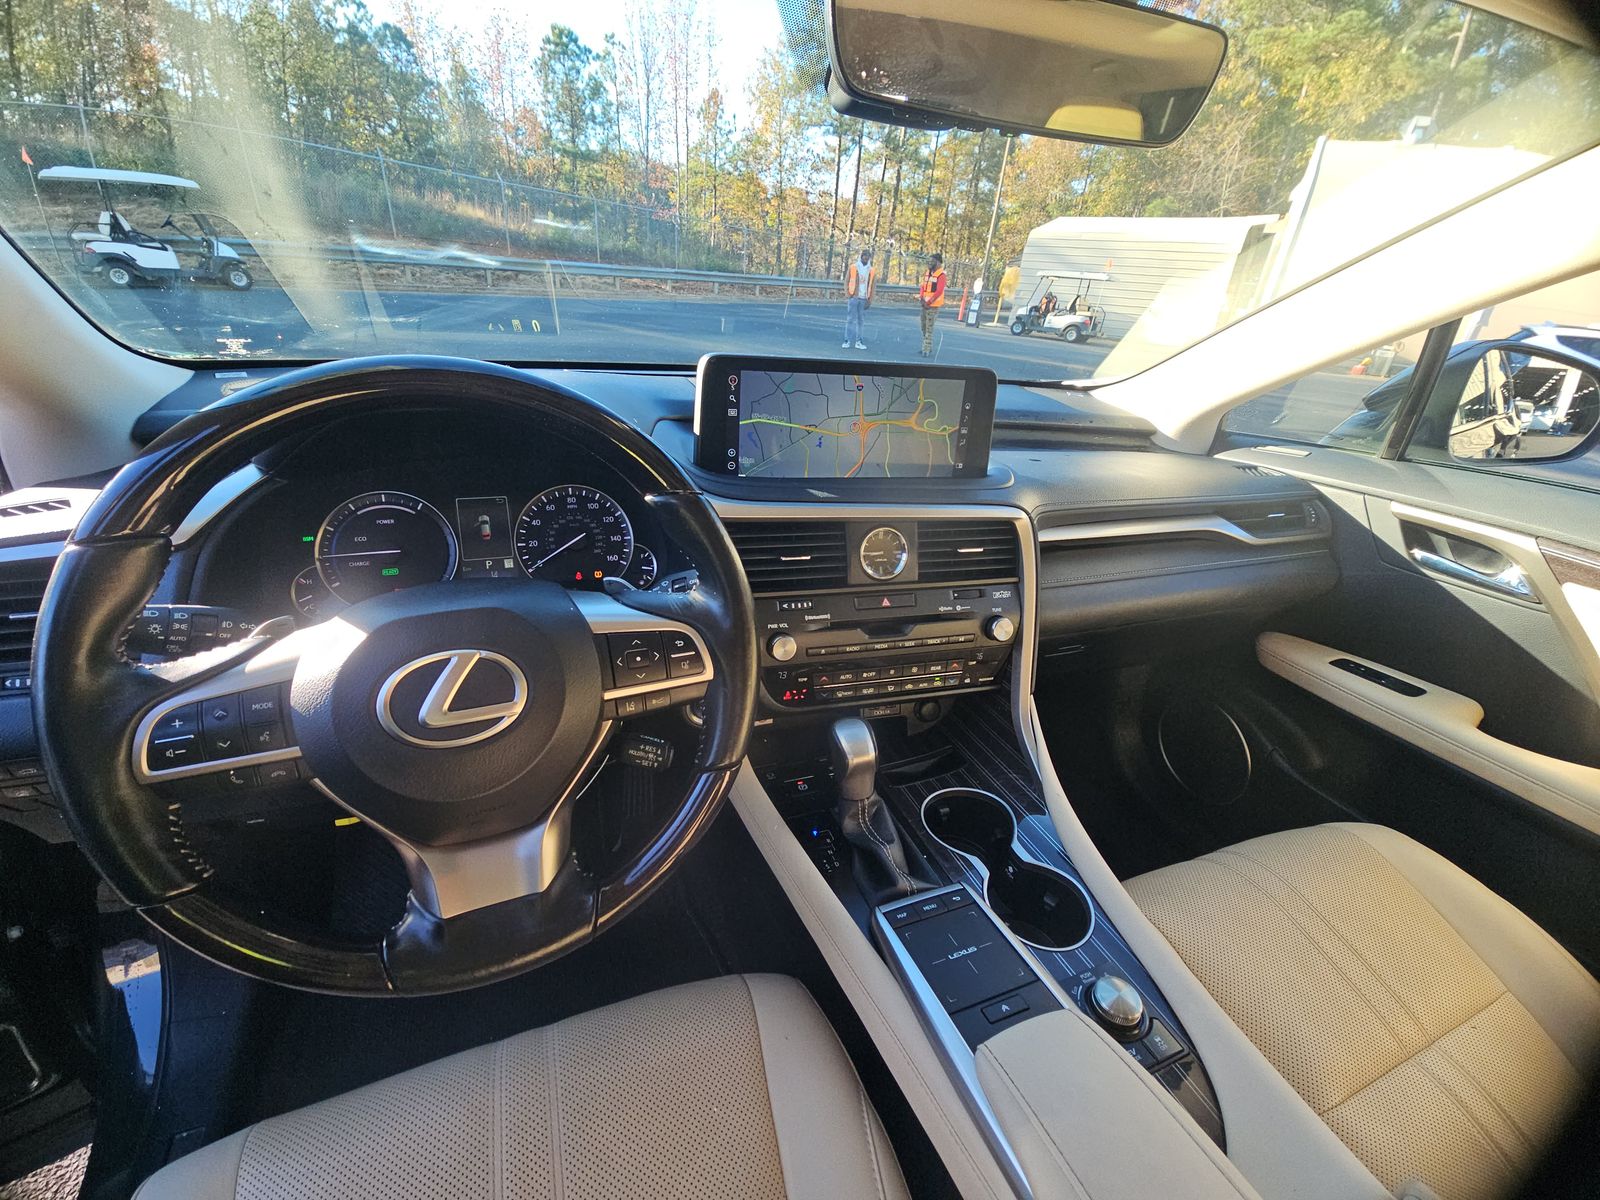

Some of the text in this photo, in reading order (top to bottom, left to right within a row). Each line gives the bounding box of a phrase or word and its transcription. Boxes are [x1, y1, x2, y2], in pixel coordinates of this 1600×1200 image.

[485, 560, 493, 569] P
[777, 671, 788, 679] 73
[251, 701, 274, 710] MODE
[923, 903, 937, 911] MENU
[948, 946, 977, 960] LEXUS
